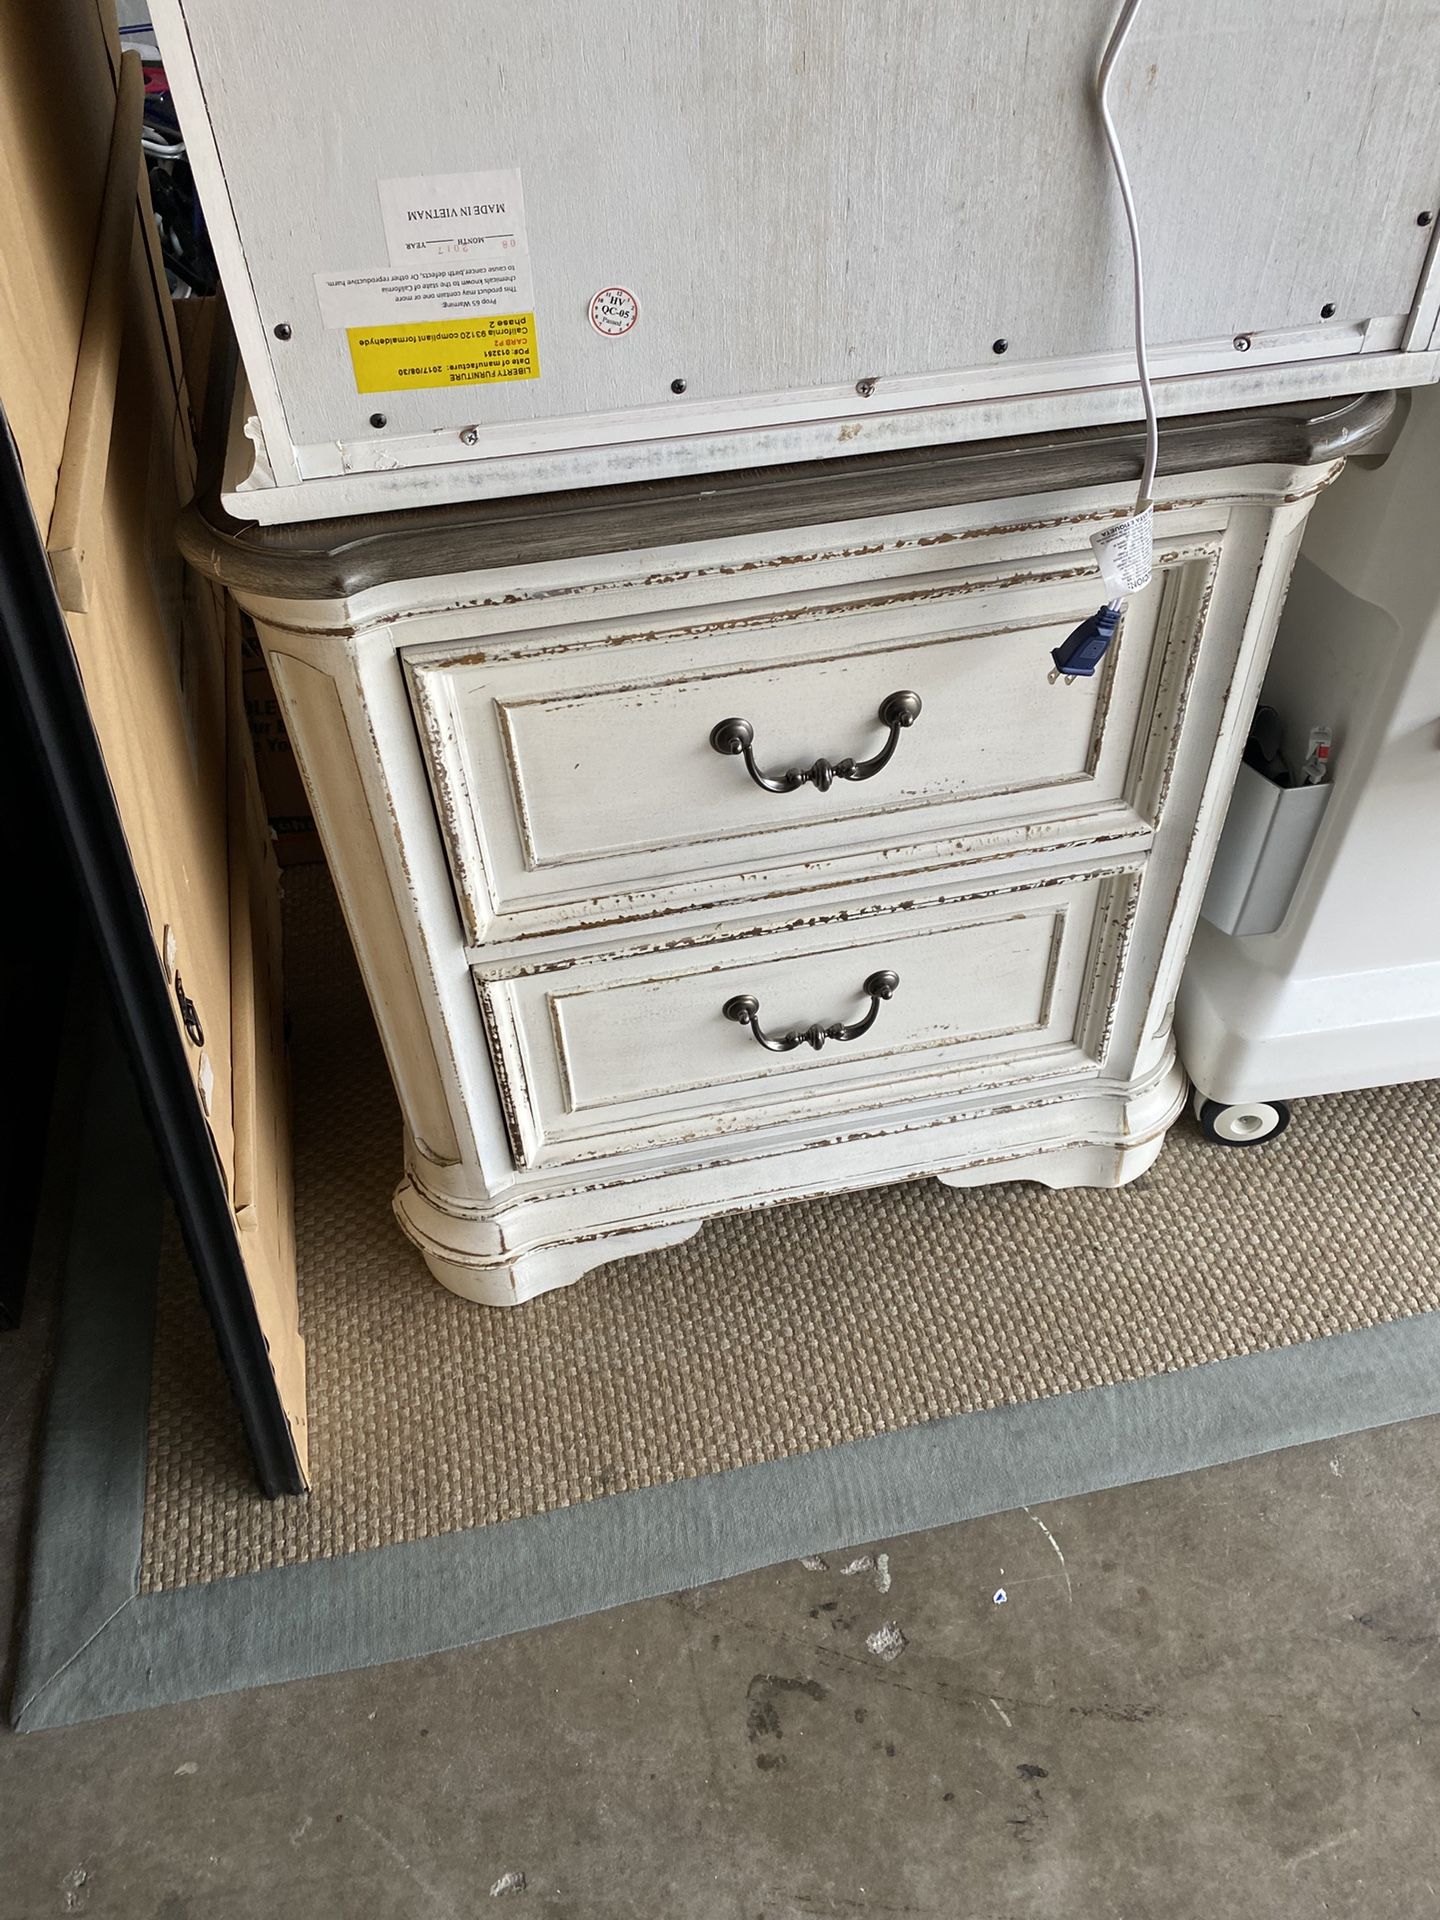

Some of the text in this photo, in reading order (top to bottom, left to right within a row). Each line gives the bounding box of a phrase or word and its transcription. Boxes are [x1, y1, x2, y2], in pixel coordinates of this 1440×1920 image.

[407, 203, 505, 221] MADE IN VIETNAM
[457, 237, 484, 245] MONTH
[438, 244, 468, 254] 2017
[347, 276, 390, 287] reproductive
[461, 279, 483, 287] known
[484, 275, 516, 284] chemicals
[382, 285, 413, 293] California
[462, 288, 476, 296] may
[477, 286, 503, 296] product
[436, 291, 461, 299] contain
[610, 296, 625, 305] HV
[602, 305, 629, 318] QC-05
[497, 317, 526, 327] phase
[359, 327, 528, 346] California 93120 compliant formaldehyde
[505, 338, 527, 346] CARB
[446, 361, 500, 371] manufacture:
[511, 358, 530, 366] Date
[398, 366, 442, 375] 2017/08/30
[450, 367, 531, 381] LIBERTY FURNITURE
